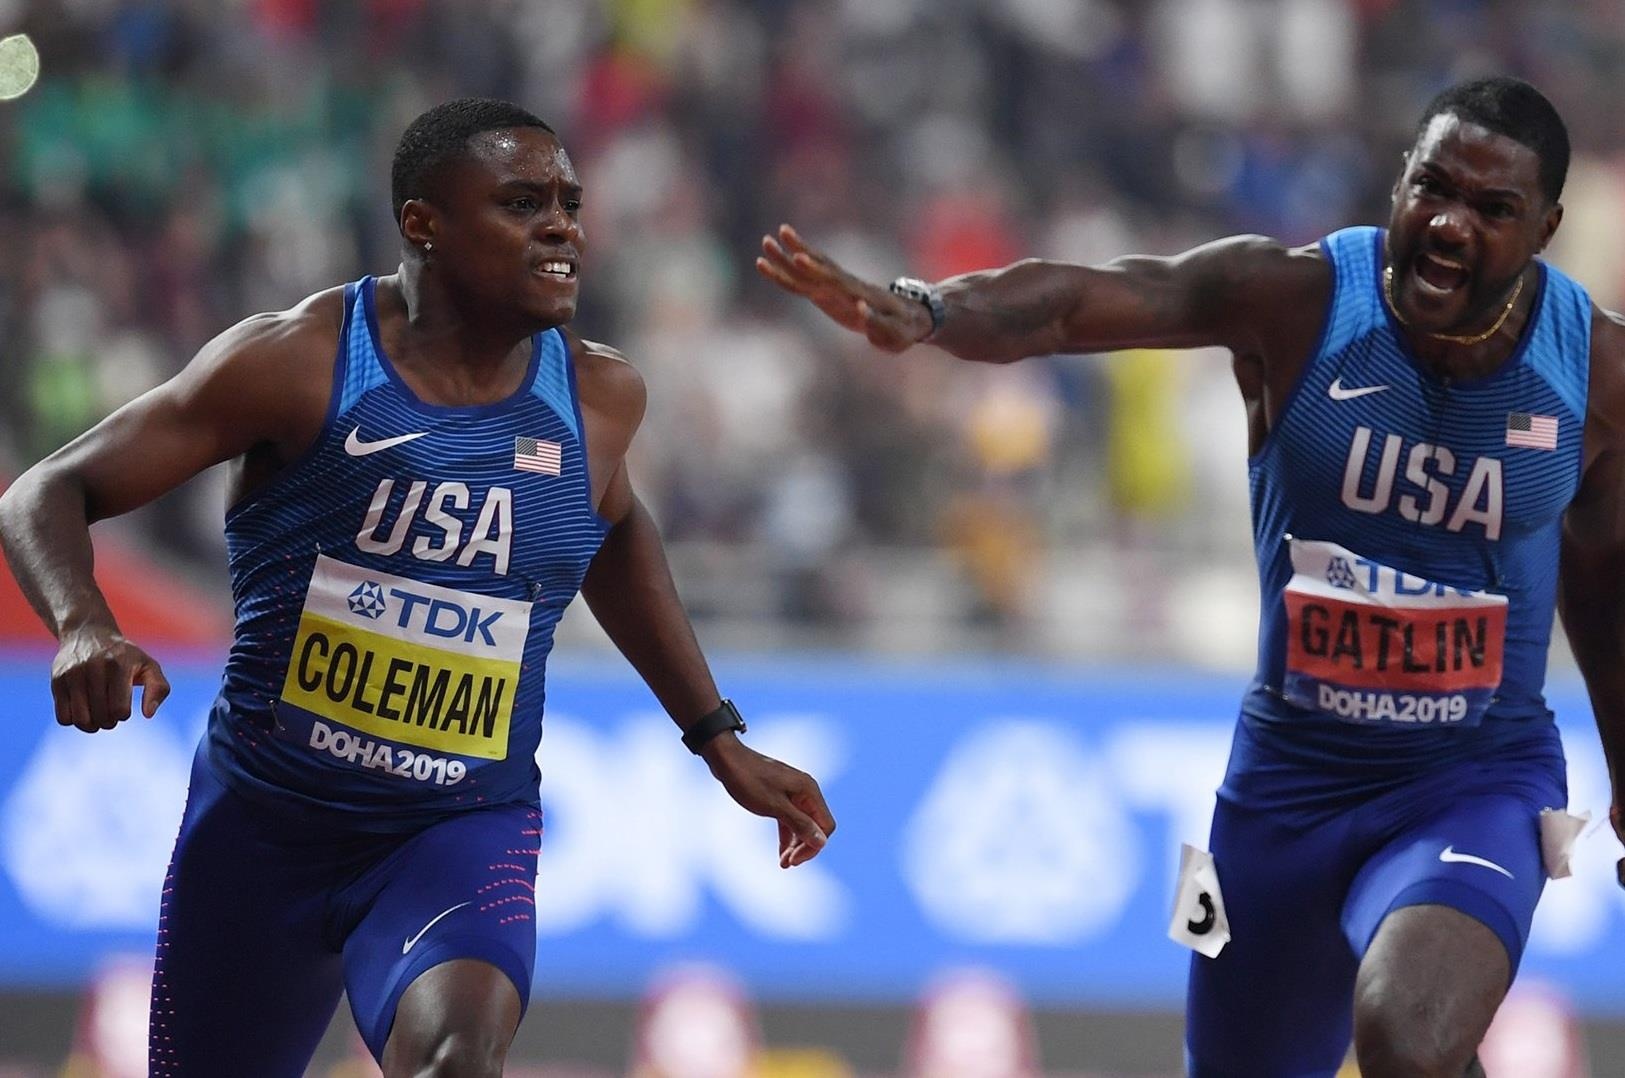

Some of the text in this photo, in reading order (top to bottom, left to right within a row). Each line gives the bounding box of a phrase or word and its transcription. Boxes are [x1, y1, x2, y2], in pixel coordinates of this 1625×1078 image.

[354, 478, 513, 576] USA
[1341, 427, 1503, 541] USA
[390, 588, 503, 646] TDK
[1302, 604, 1488, 673] GATLIN
[298, 632, 506, 739] COLEMAN
